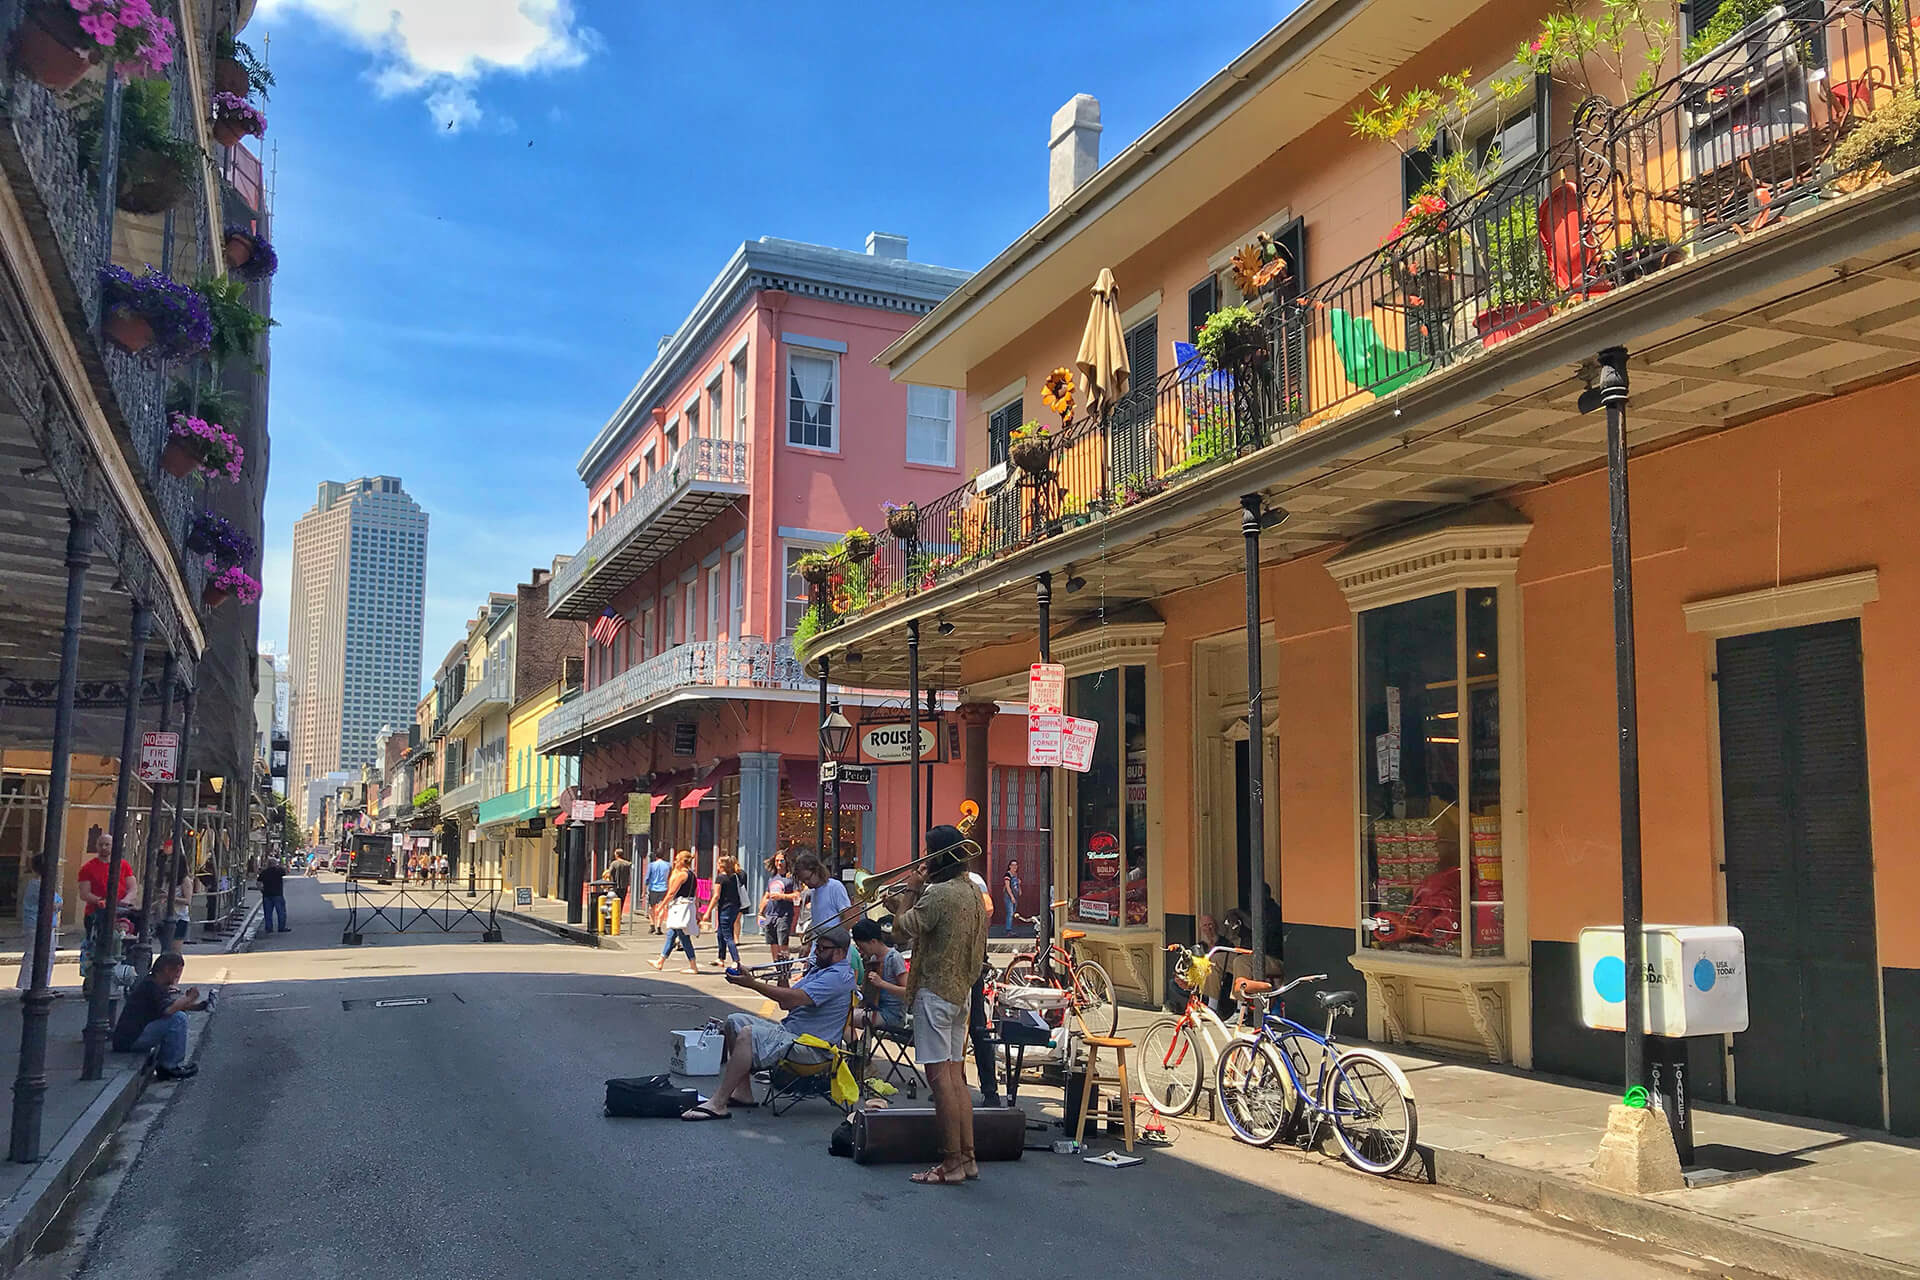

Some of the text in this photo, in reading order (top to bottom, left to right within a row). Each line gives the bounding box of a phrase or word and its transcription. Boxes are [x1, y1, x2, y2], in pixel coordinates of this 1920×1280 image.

[1031, 719, 1062, 728] NO STOPPING
[1074, 723, 1096, 733] PARKING
[144, 734, 155, 745] NO
[1064, 734, 1091, 746] FREIGHT
[1066, 743, 1084, 753] ZONE
[150, 749, 168, 758] FIRE
[148, 759, 169, 768] LANE
[845, 770, 869, 780] Peter
[799, 800, 870, 811] FISCR AMBINO
[1641, 973, 1669, 984] ODAY
[1675, 1070, 1686, 1129] GANNETT
